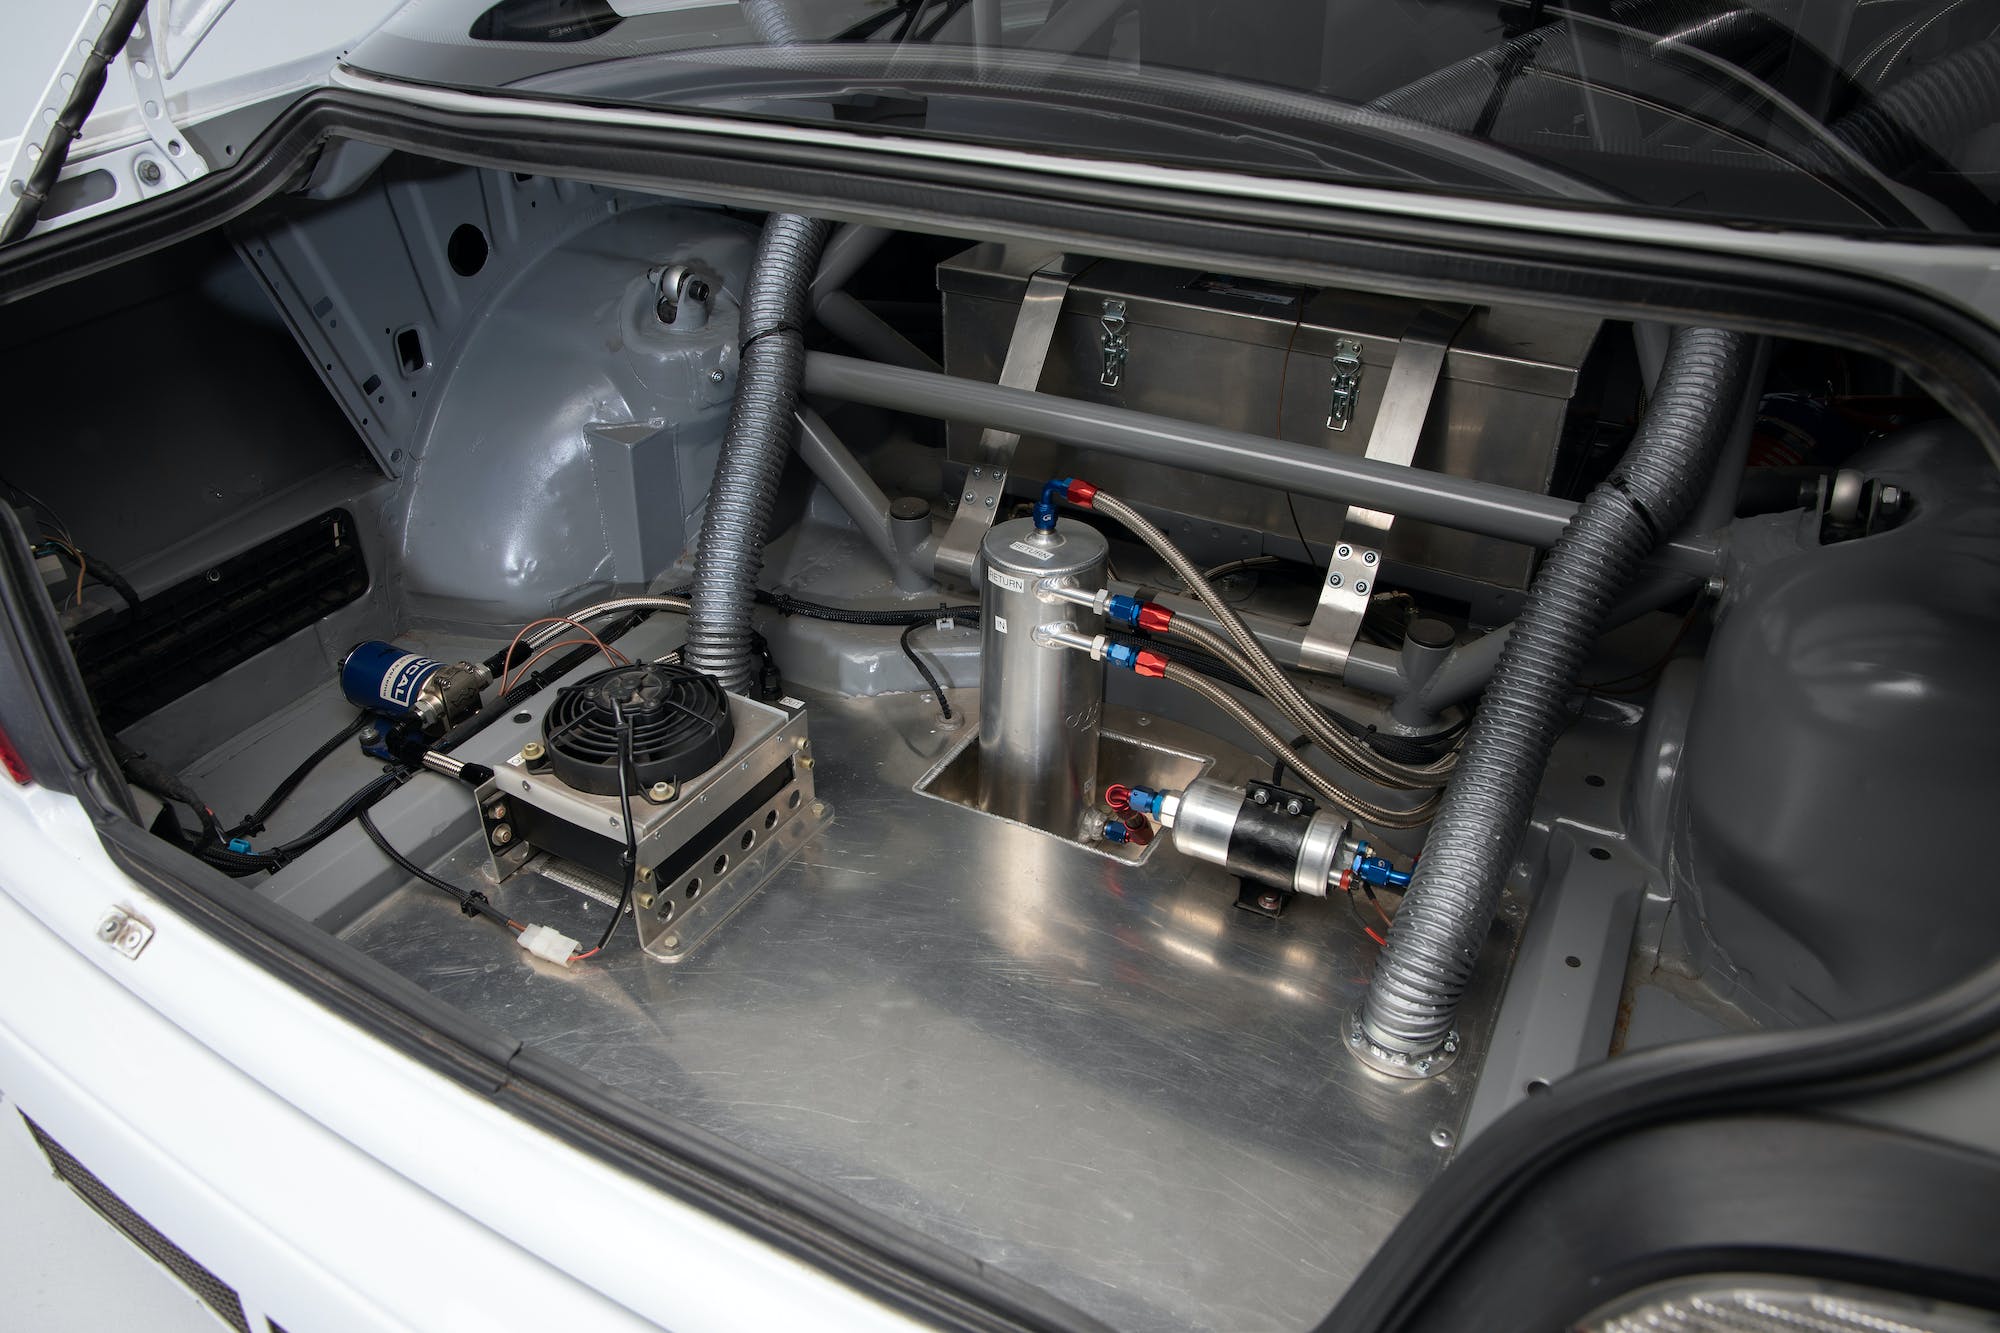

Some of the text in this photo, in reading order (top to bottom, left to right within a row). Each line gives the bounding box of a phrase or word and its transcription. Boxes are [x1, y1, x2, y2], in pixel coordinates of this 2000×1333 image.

[1011, 542, 1052, 559] RETURN
[988, 570, 1023, 590] RETURN
[996, 619, 1006, 631] IN
[394, 657, 436, 700] OCAL
